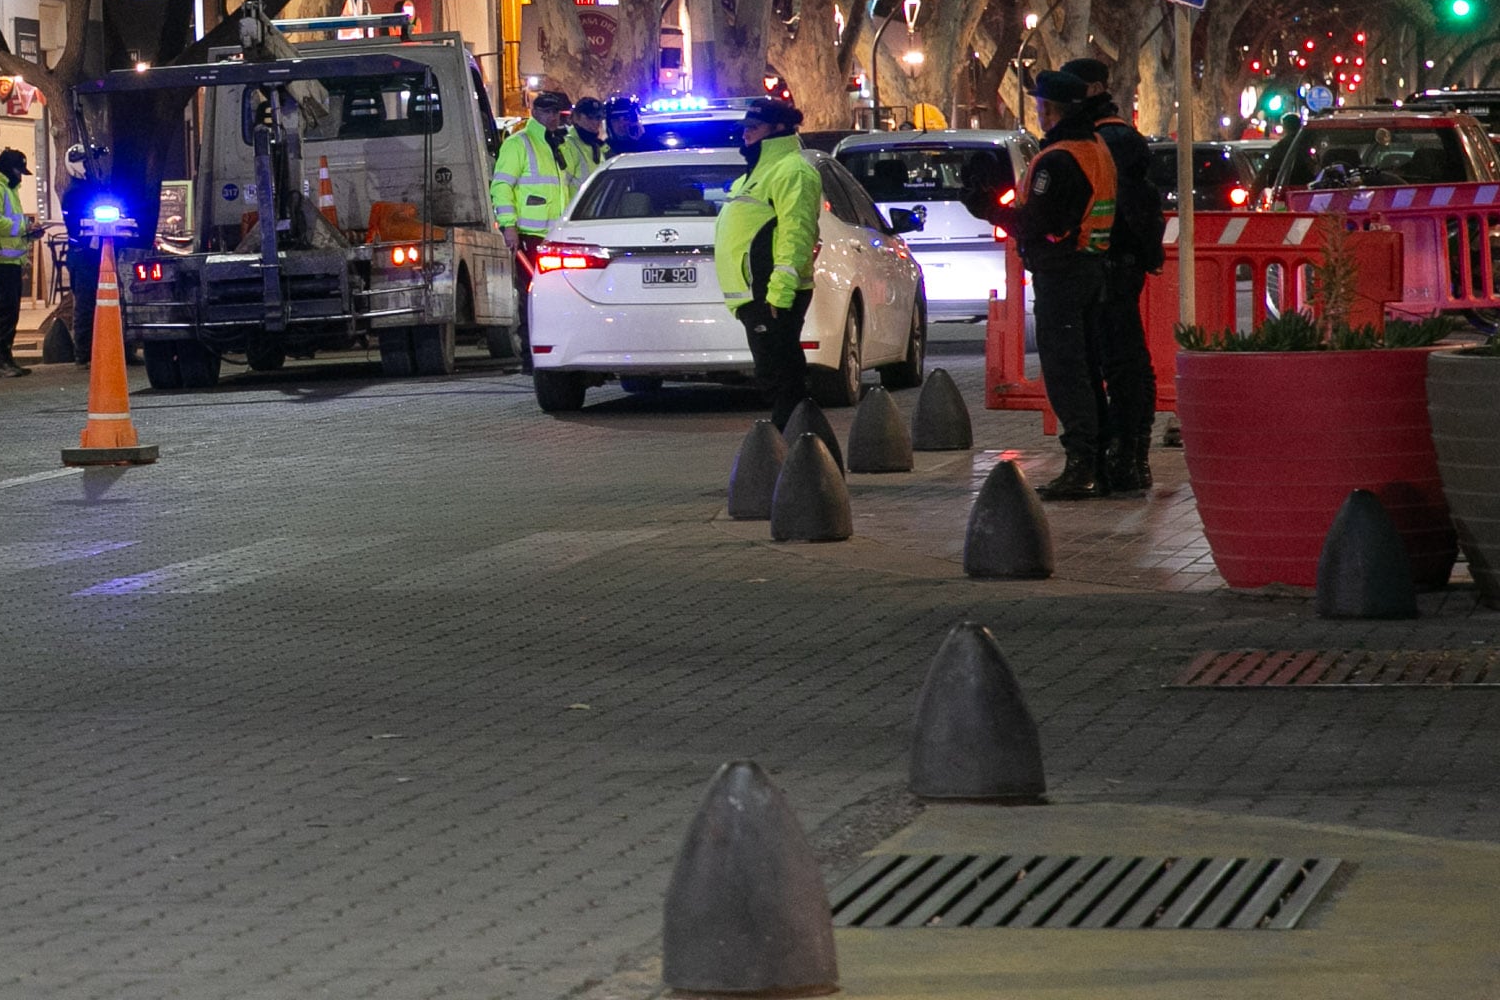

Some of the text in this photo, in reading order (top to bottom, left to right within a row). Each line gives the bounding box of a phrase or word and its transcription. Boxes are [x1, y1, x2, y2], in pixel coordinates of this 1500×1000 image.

[435, 171, 451, 181] 317
[222, 187, 240, 197] 317
[643, 269, 696, 283] OHZ 920
